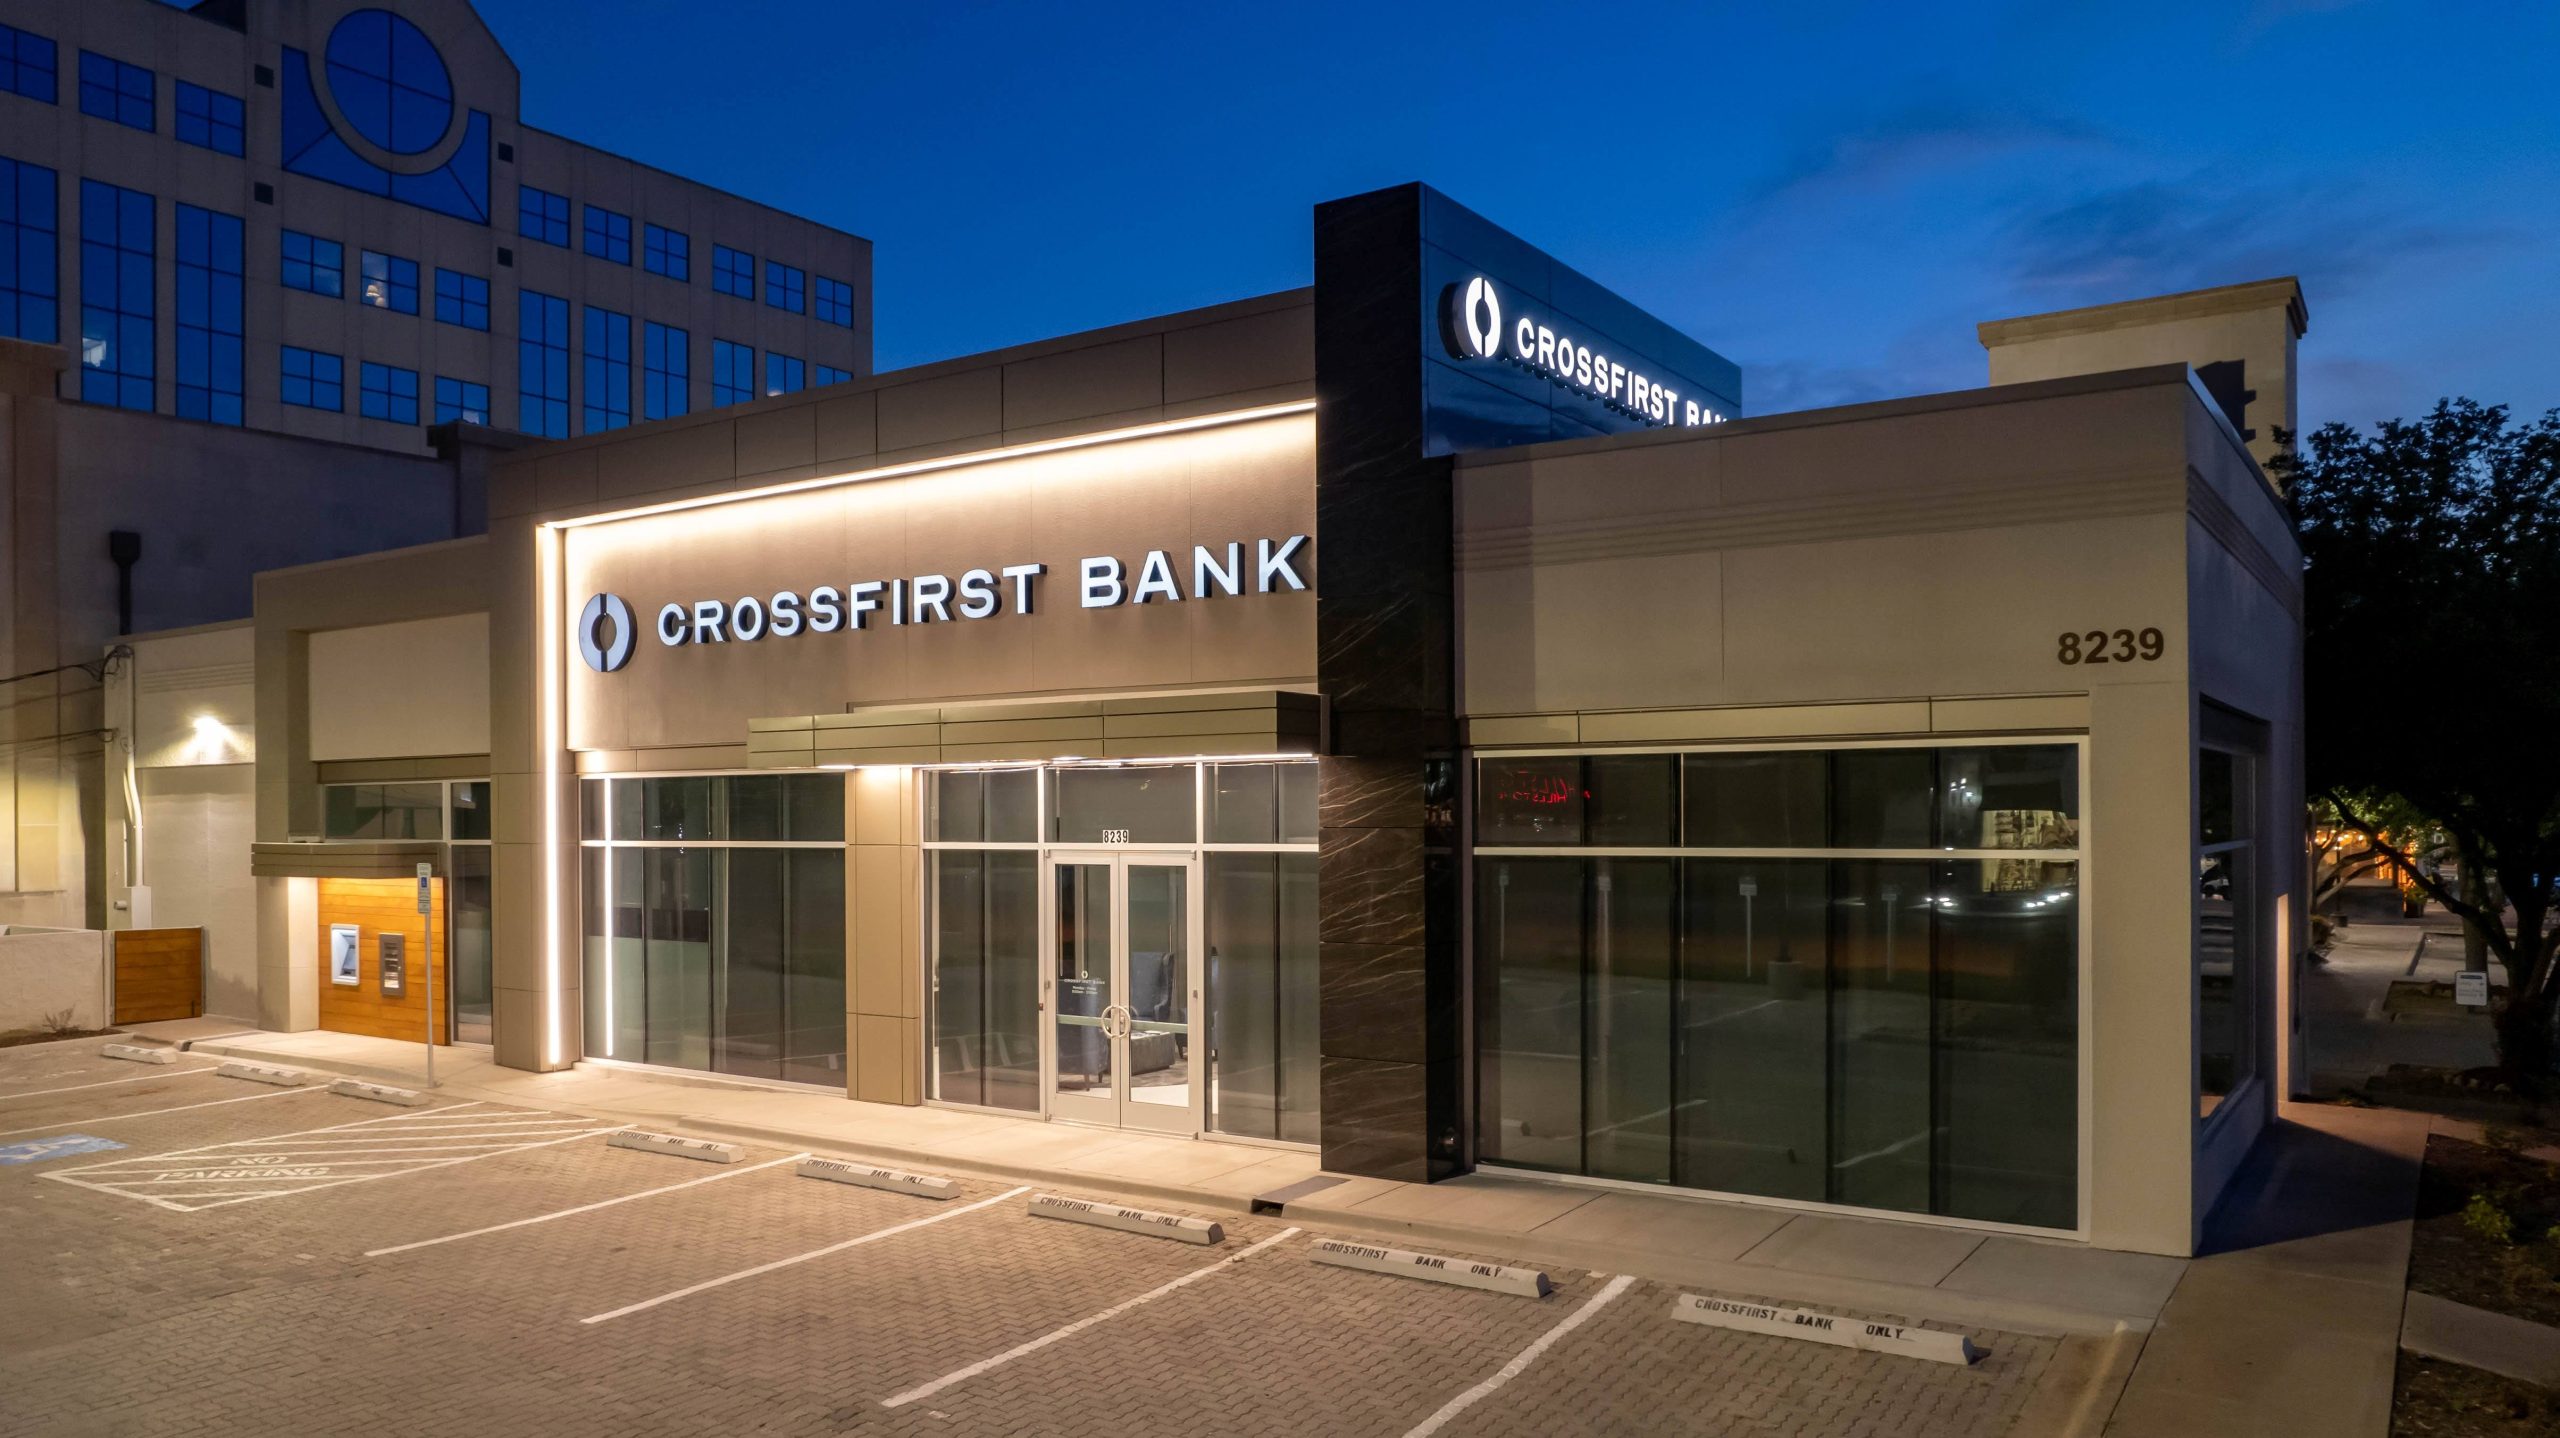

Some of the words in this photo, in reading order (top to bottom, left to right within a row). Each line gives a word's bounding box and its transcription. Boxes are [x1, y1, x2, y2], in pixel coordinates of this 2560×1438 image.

[1517, 317, 1678, 425] CROSSFIRST
[1686, 399, 1728, 427] BA
[657, 563, 1048, 648] CROSSFIRST
[1080, 534, 1311, 610] BANK
[2057, 626, 2165, 666] 8239
[1103, 830, 1128, 843] 8239
[154, 1167, 330, 1181] PARKING
[230, 1156, 288, 1165] NO
[1040, 1196, 1094, 1213] CROSSFIRST
[1117, 1209, 1144, 1221] BANK
[1156, 1215, 1182, 1227] ONLY
[1321, 1241, 1389, 1260] CROSSFIRST
[1415, 1255, 1447, 1270] BANK
[1470, 1264, 1502, 1278] ONLY
[1695, 1298, 1778, 1321] CROSSFIRST
[1795, 1313, 1834, 1331] BANK
[1865, 1323, 1904, 1340] ONLY
